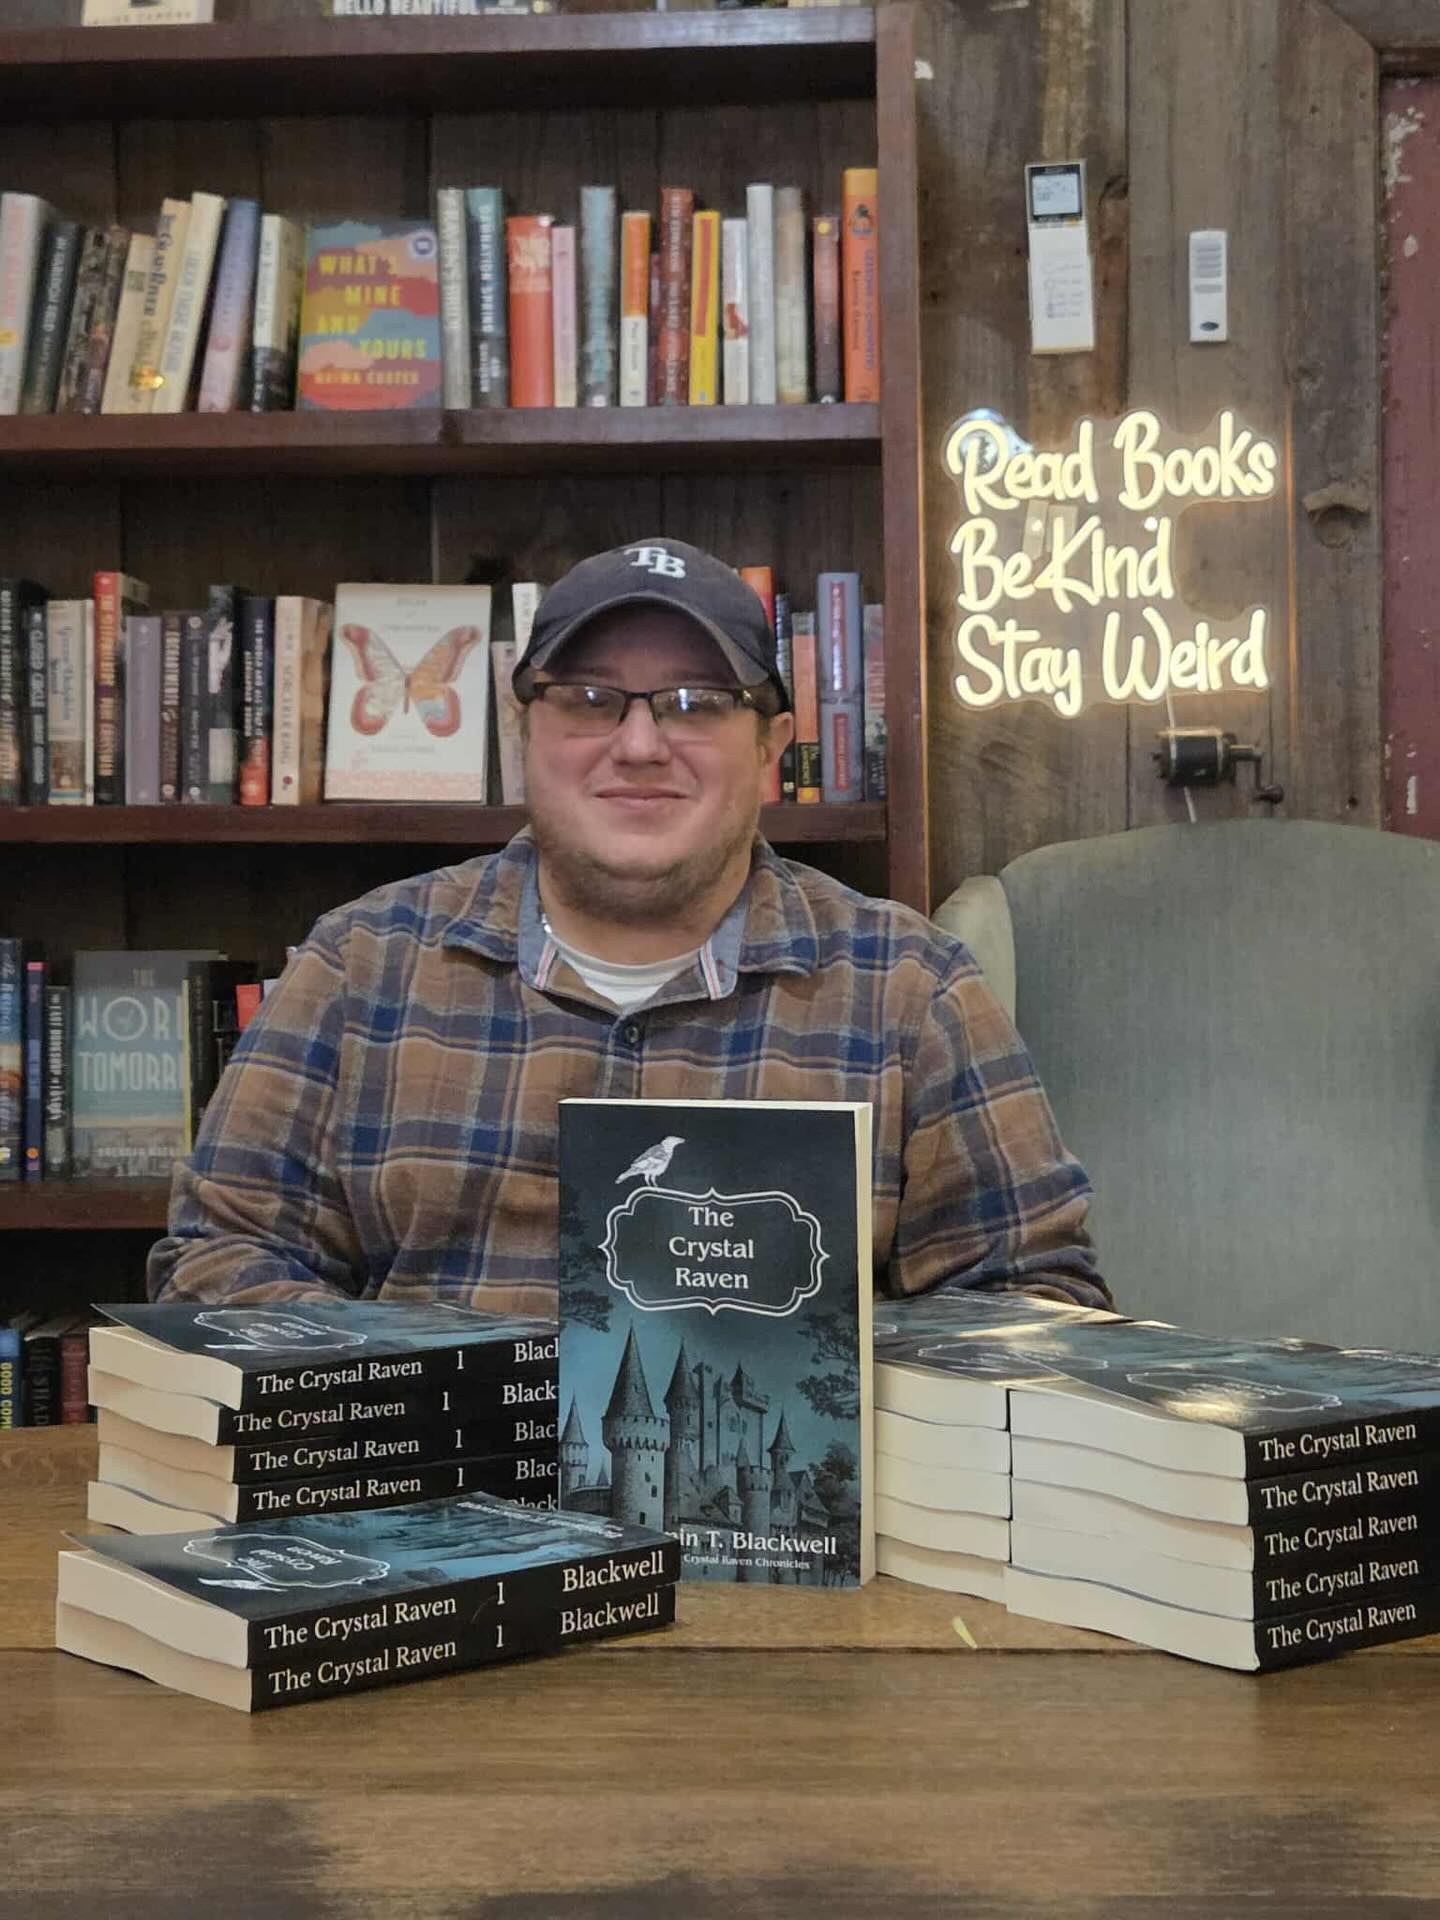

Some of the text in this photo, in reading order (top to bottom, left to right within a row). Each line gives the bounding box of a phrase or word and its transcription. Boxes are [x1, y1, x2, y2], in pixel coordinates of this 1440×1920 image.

[345, 286, 401, 306] MINE
[480, 286, 494, 333] SPRING
[318, 315, 360, 335] AND
[360, 338, 426, 360] YOURS
[947, 411, 1276, 515] Read Books
[624, 546, 686, 578] TB
[951, 517, 1036, 611] Be
[955, 613, 1083, 716] Stay
[1102, 607, 1269, 700] Weird
[688, 1206, 735, 1228] The
[668, 1236, 755, 1262] Crystal
[675, 1267, 749, 1290] Raven
[257, 1374, 294, 1395] The
[299, 1364, 363, 1391] Crystal
[368, 1359, 423, 1380] Raven
[457, 1350, 464, 1370] 1
[233, 1379, 559, 1433] The Crystal Raven 1 Black
[250, 1417, 558, 1472] The Crystal Raven 1 Blac
[1259, 1423, 1417, 1461] The Crystal Raven
[253, 1489, 291, 1511] The
[296, 1478, 361, 1506] Crystal
[367, 1476, 421, 1498] Raven
[457, 1467, 464, 1487] 1
[1261, 1469, 1419, 1510] The Crystal Raven
[706, 1530, 724, 1549] T.
[732, 1531, 837, 1555] Blackwell
[1264, 1514, 1418, 1556] The Crystal Raven
[683, 1552, 811, 1570] Crystal Raven Chronicles
[1266, 1559, 1419, 1601] The Crystal Raven
[264, 1550, 664, 1650] The Crystal Raven 1 Blackwell
[268, 1593, 660, 1695] The Crystal Raven 1 Blackwell
[1267, 1603, 1417, 1648] The Crystal Raven
